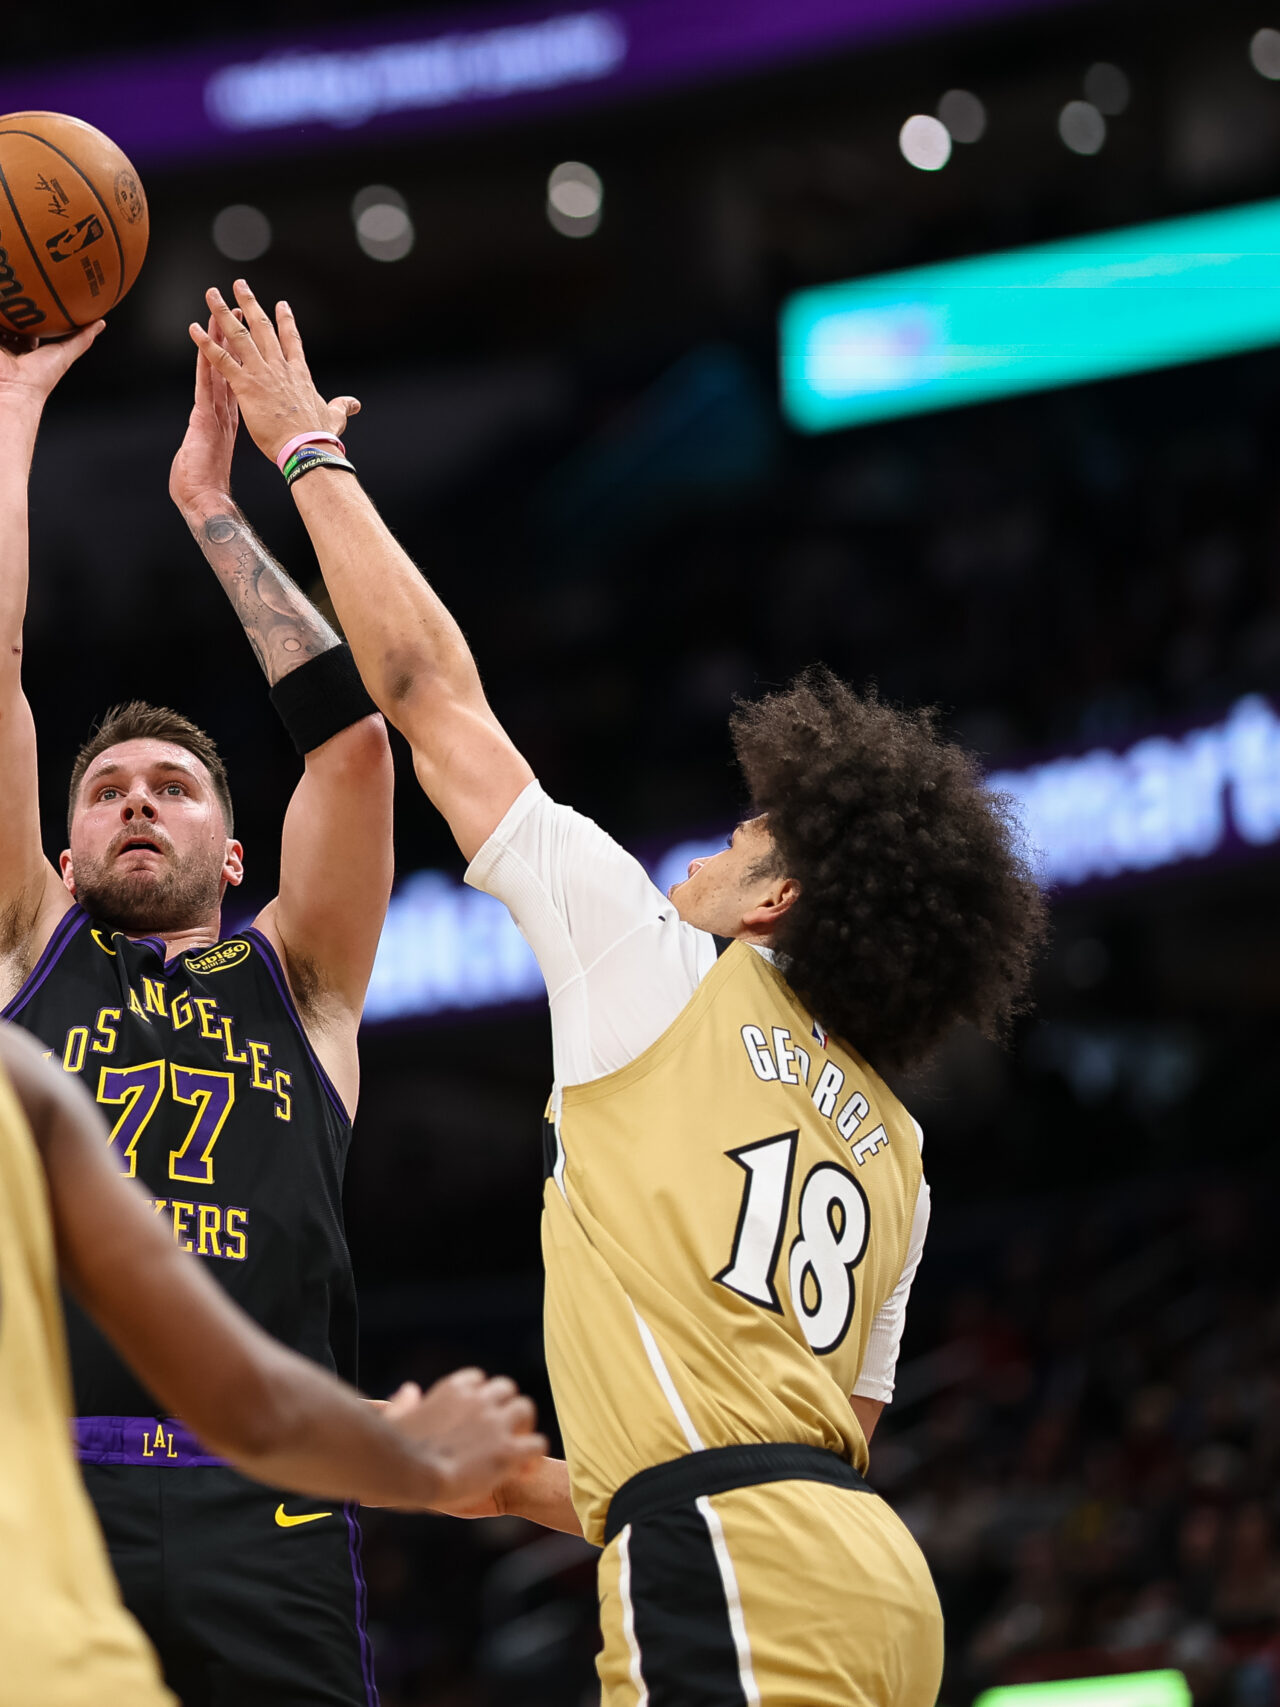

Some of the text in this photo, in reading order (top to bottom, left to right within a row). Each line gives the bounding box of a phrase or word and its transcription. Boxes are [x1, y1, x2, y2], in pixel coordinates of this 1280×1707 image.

[189, 944, 246, 970] bibigo
[127, 975, 293, 1123] ANGELES
[96, 1058, 236, 1185] 77
[144, 1196, 250, 1262] ERS
[711, 1128, 871, 1356] 18
[142, 1424, 178, 1458] LAL
